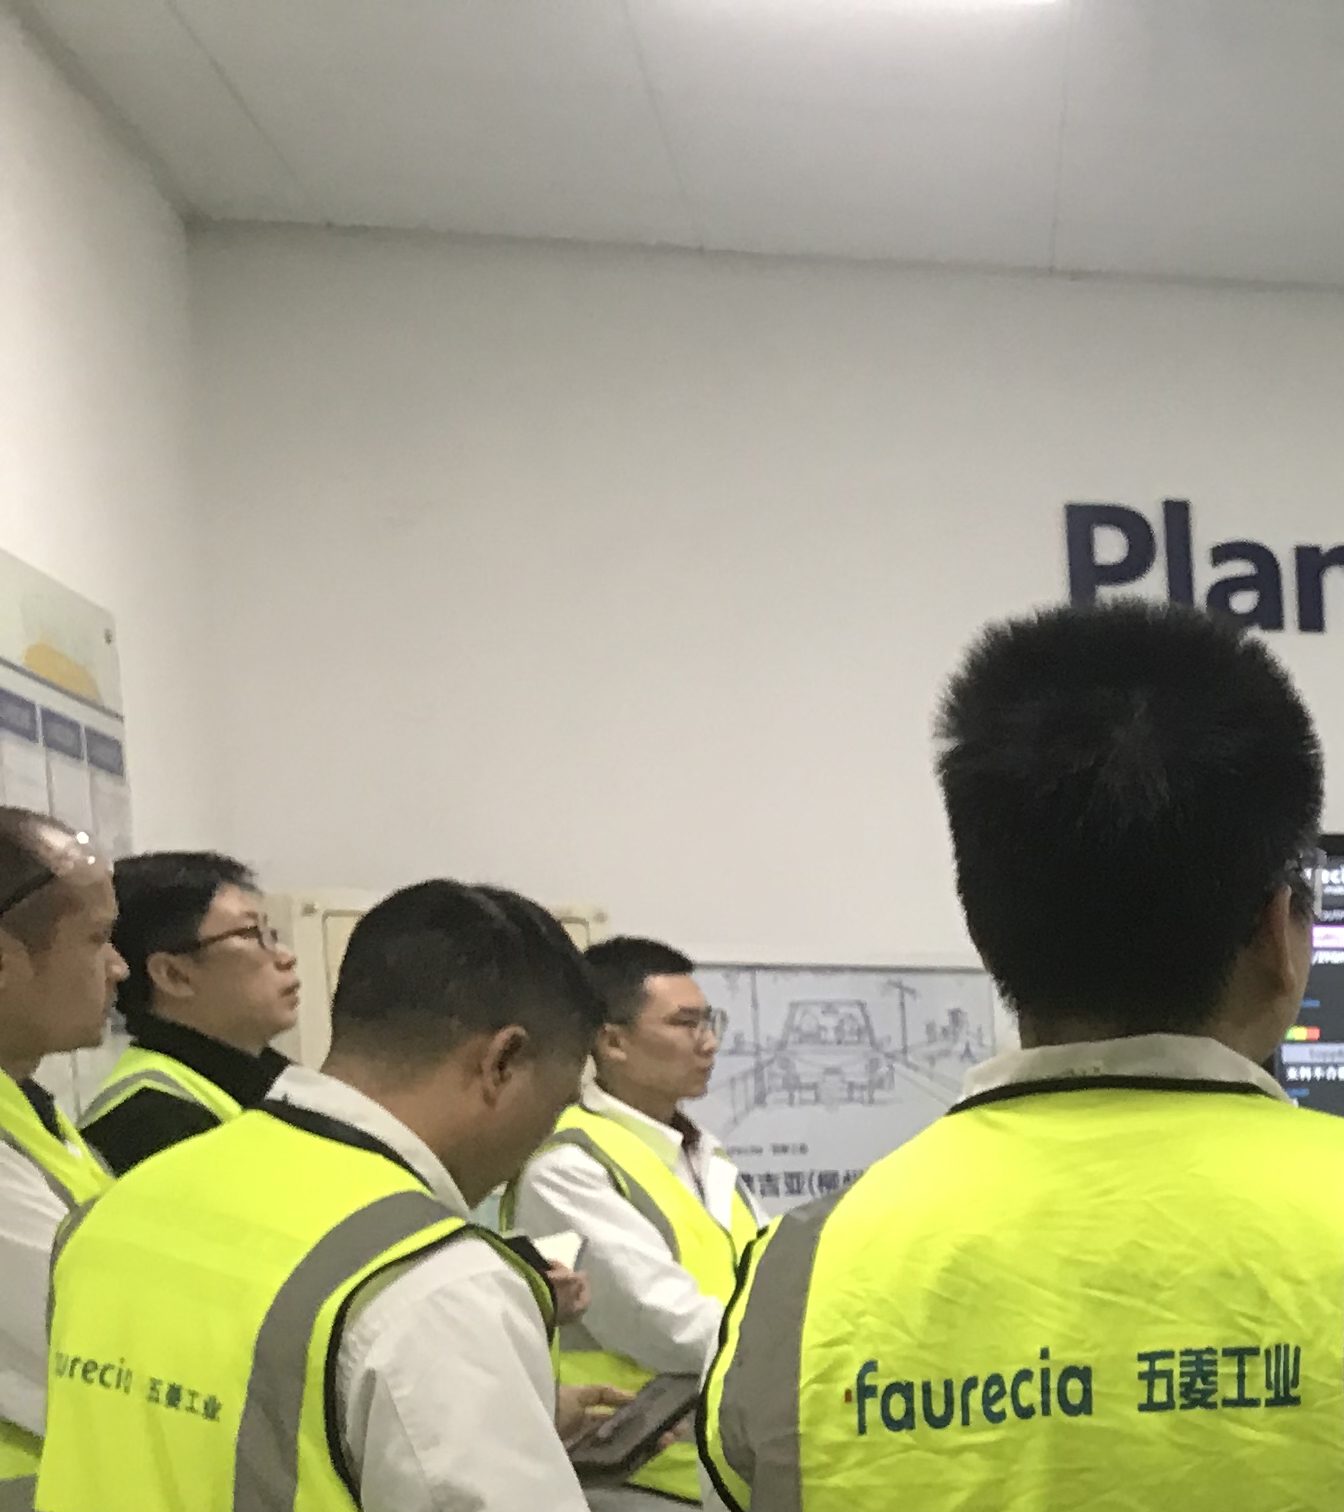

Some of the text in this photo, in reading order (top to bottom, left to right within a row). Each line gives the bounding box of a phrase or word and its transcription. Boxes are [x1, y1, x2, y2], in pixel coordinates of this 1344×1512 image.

[856, 1343, 1301, 1437] faurecia 五菱工业
